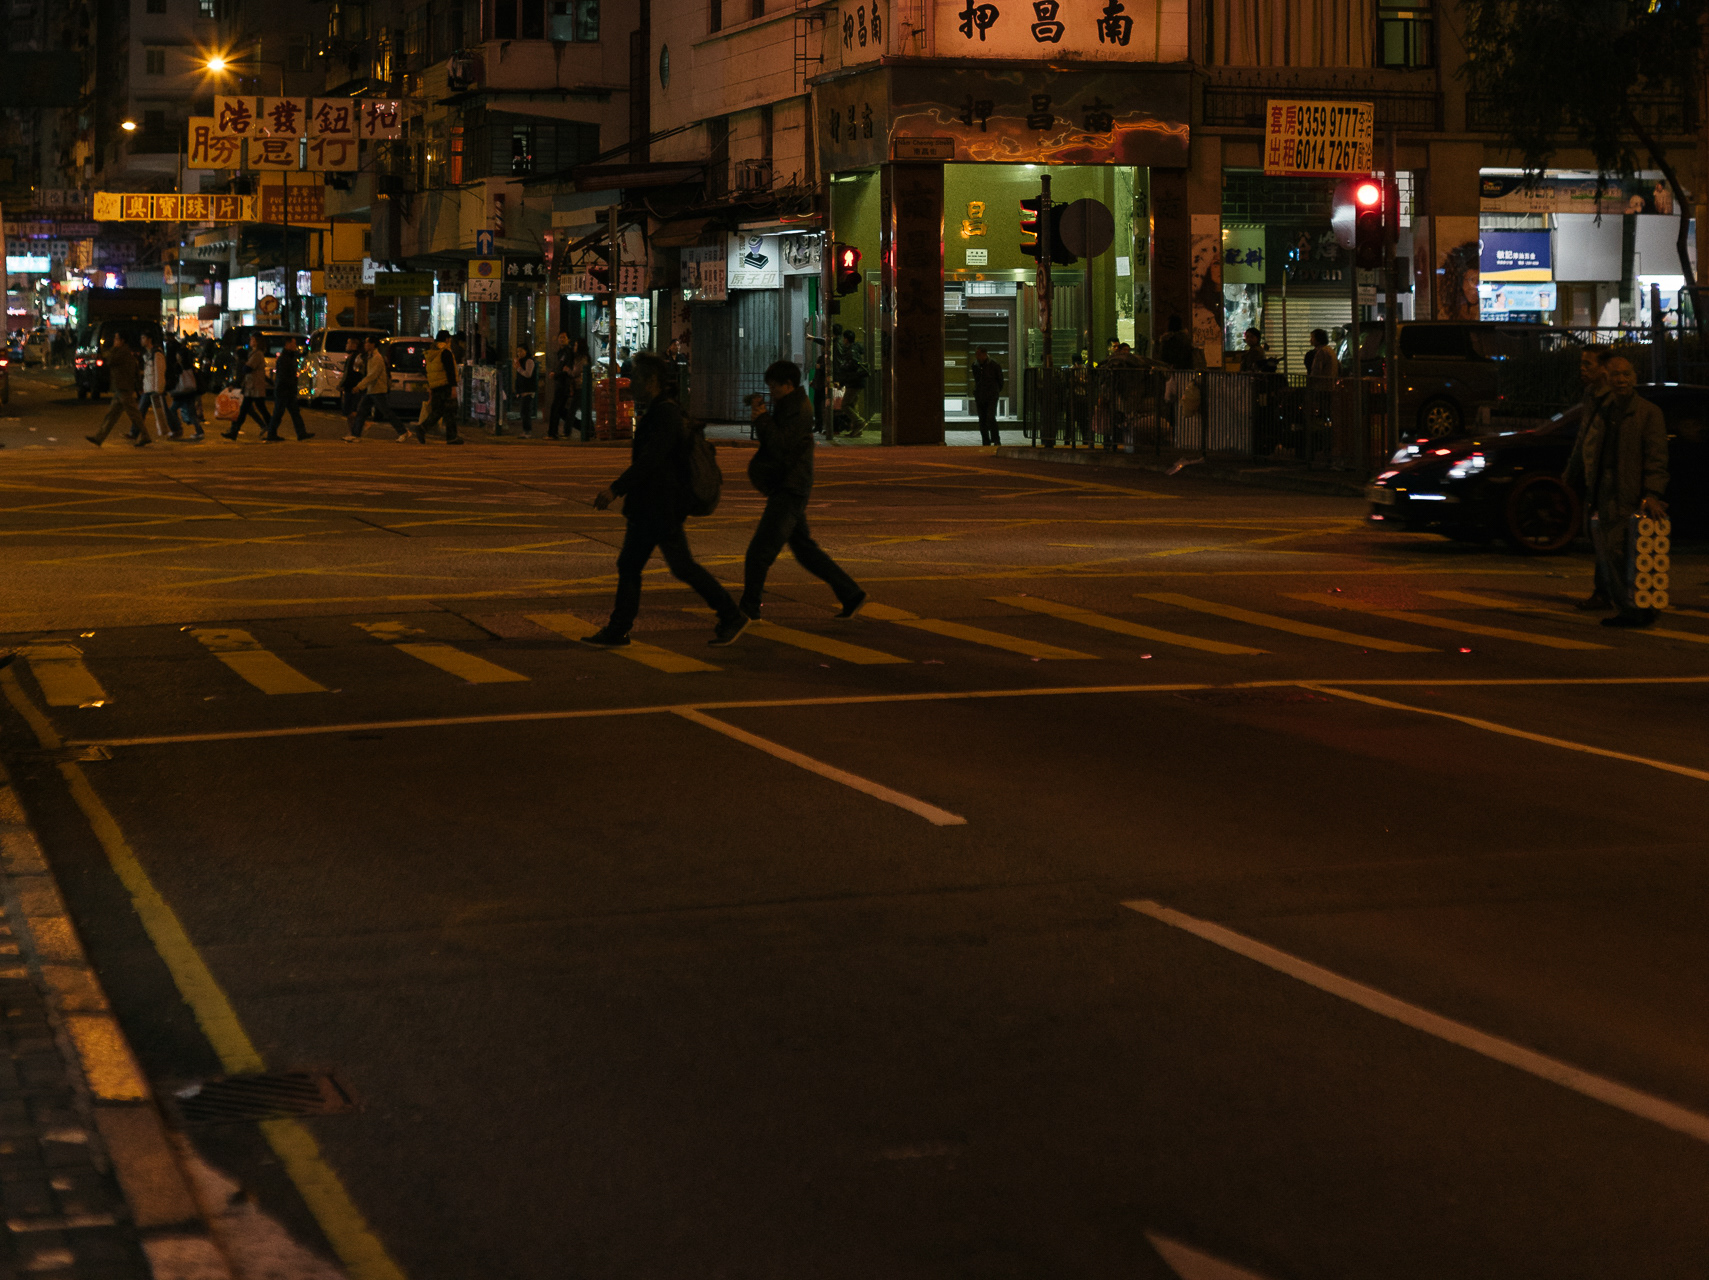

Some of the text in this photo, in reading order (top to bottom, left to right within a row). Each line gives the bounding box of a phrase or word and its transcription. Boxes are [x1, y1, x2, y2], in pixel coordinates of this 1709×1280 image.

[1297, 106, 1327, 137] 9359
[1330, 107, 1359, 138] 9777
[912, 139, 934, 147] Cheong
[1269, 137, 1296, 168] 出租
[1296, 139, 1326, 170] 6014
[1329, 140, 1359, 171] 7267
